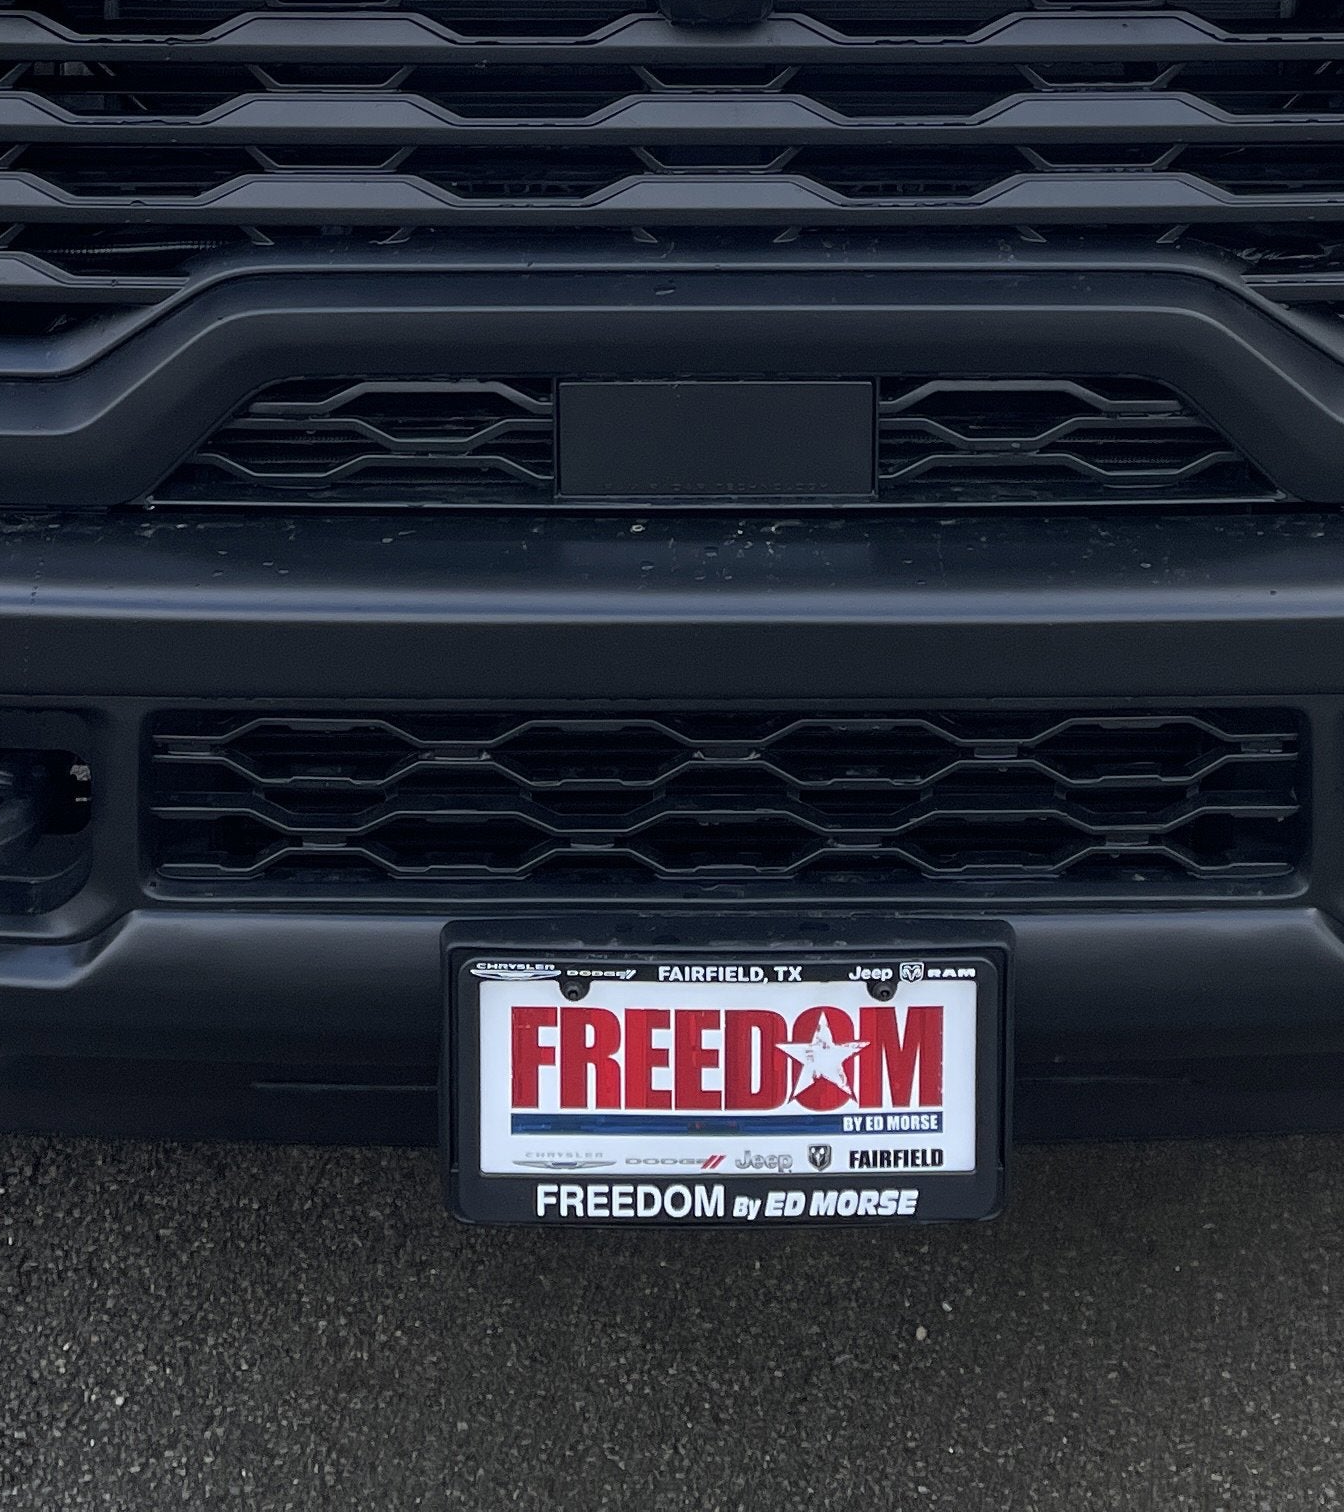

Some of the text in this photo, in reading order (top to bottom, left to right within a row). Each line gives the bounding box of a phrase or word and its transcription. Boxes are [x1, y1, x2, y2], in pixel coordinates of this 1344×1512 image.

[476, 962, 555, 971] CHRYSLER
[658, 966, 803, 984] FAIRFIELD, TX
[848, 966, 893, 982] Jeep
[927, 968, 977, 978] RAM
[510, 1005, 945, 1112] FREEDOM
[843, 1114, 939, 1131] BY ED MORSE
[734, 1149, 794, 1173] Jeep
[849, 1148, 944, 1169] FAIRFIELD
[536, 1183, 726, 1218] FREEDOM
[764, 1190, 807, 1217] ED
[809, 1188, 920, 1217] MORSE
